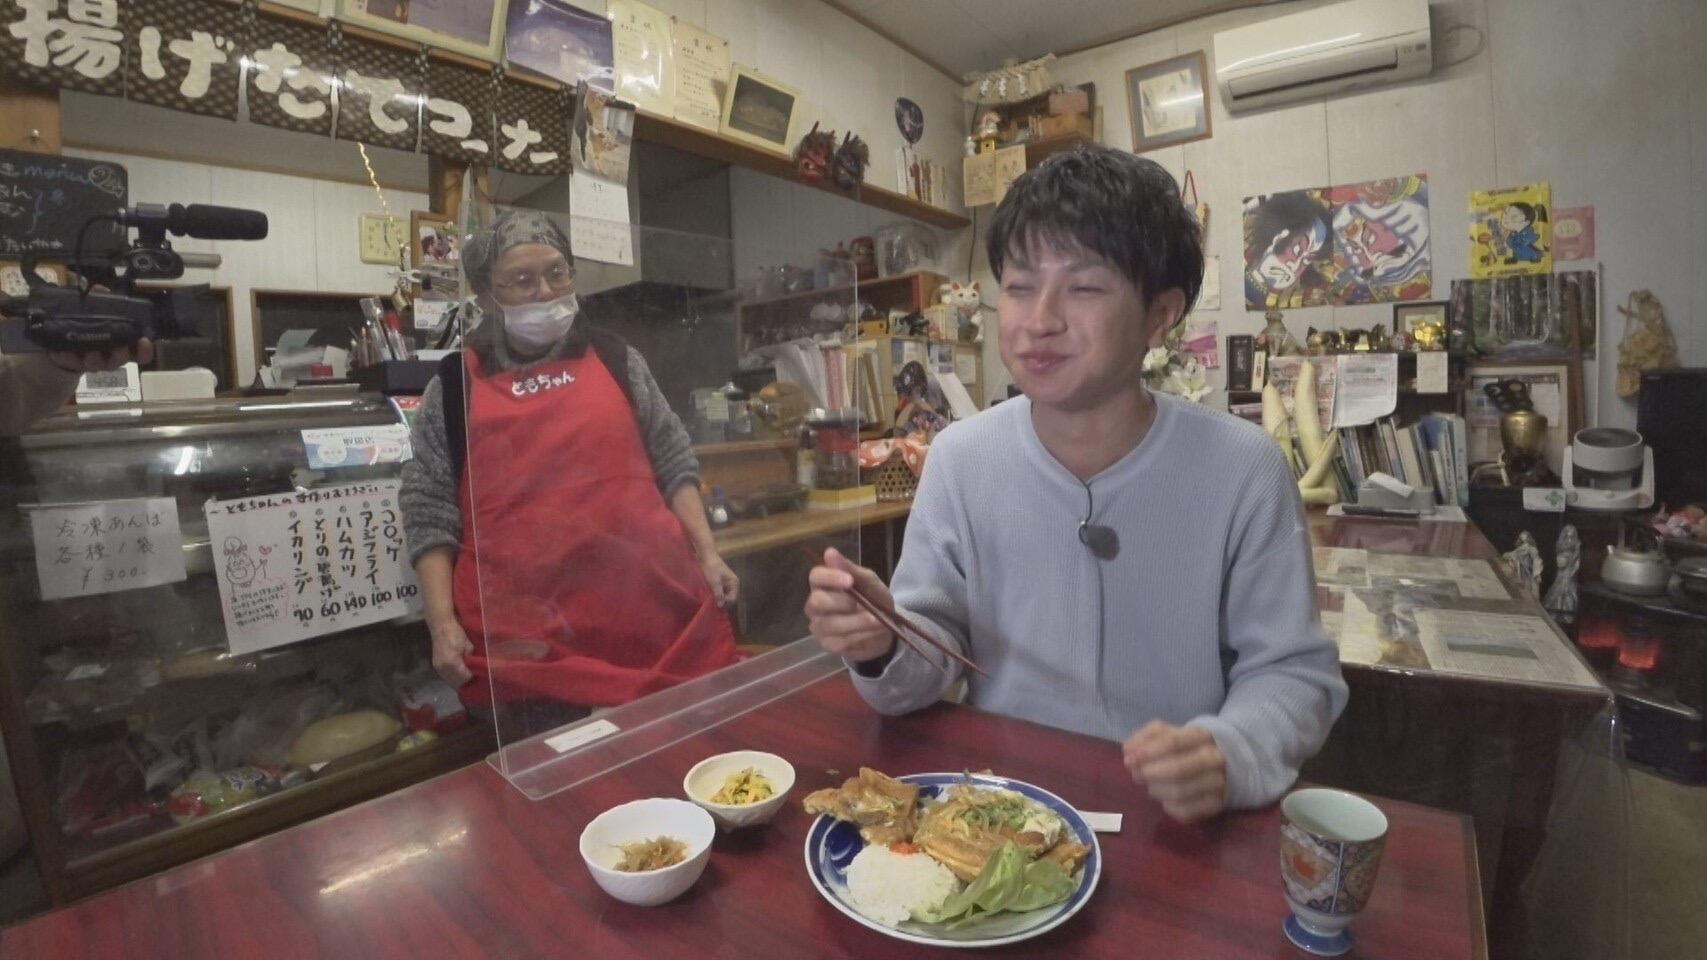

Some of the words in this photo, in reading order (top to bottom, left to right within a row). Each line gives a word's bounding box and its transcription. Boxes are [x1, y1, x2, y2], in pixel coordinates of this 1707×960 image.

[511, 371, 576, 396] ともちゃん
[336, 515, 356, 577] ハムカツ
[359, 510, 379, 585] アジフライ
[381, 509, 404, 563] コロッケ
[288, 519, 313, 595] イカリング
[370, 590, 392, 607] 100
[395, 584, 418, 599] 100
[293, 606, 314, 622] 70
[320, 601, 341, 617] 60
